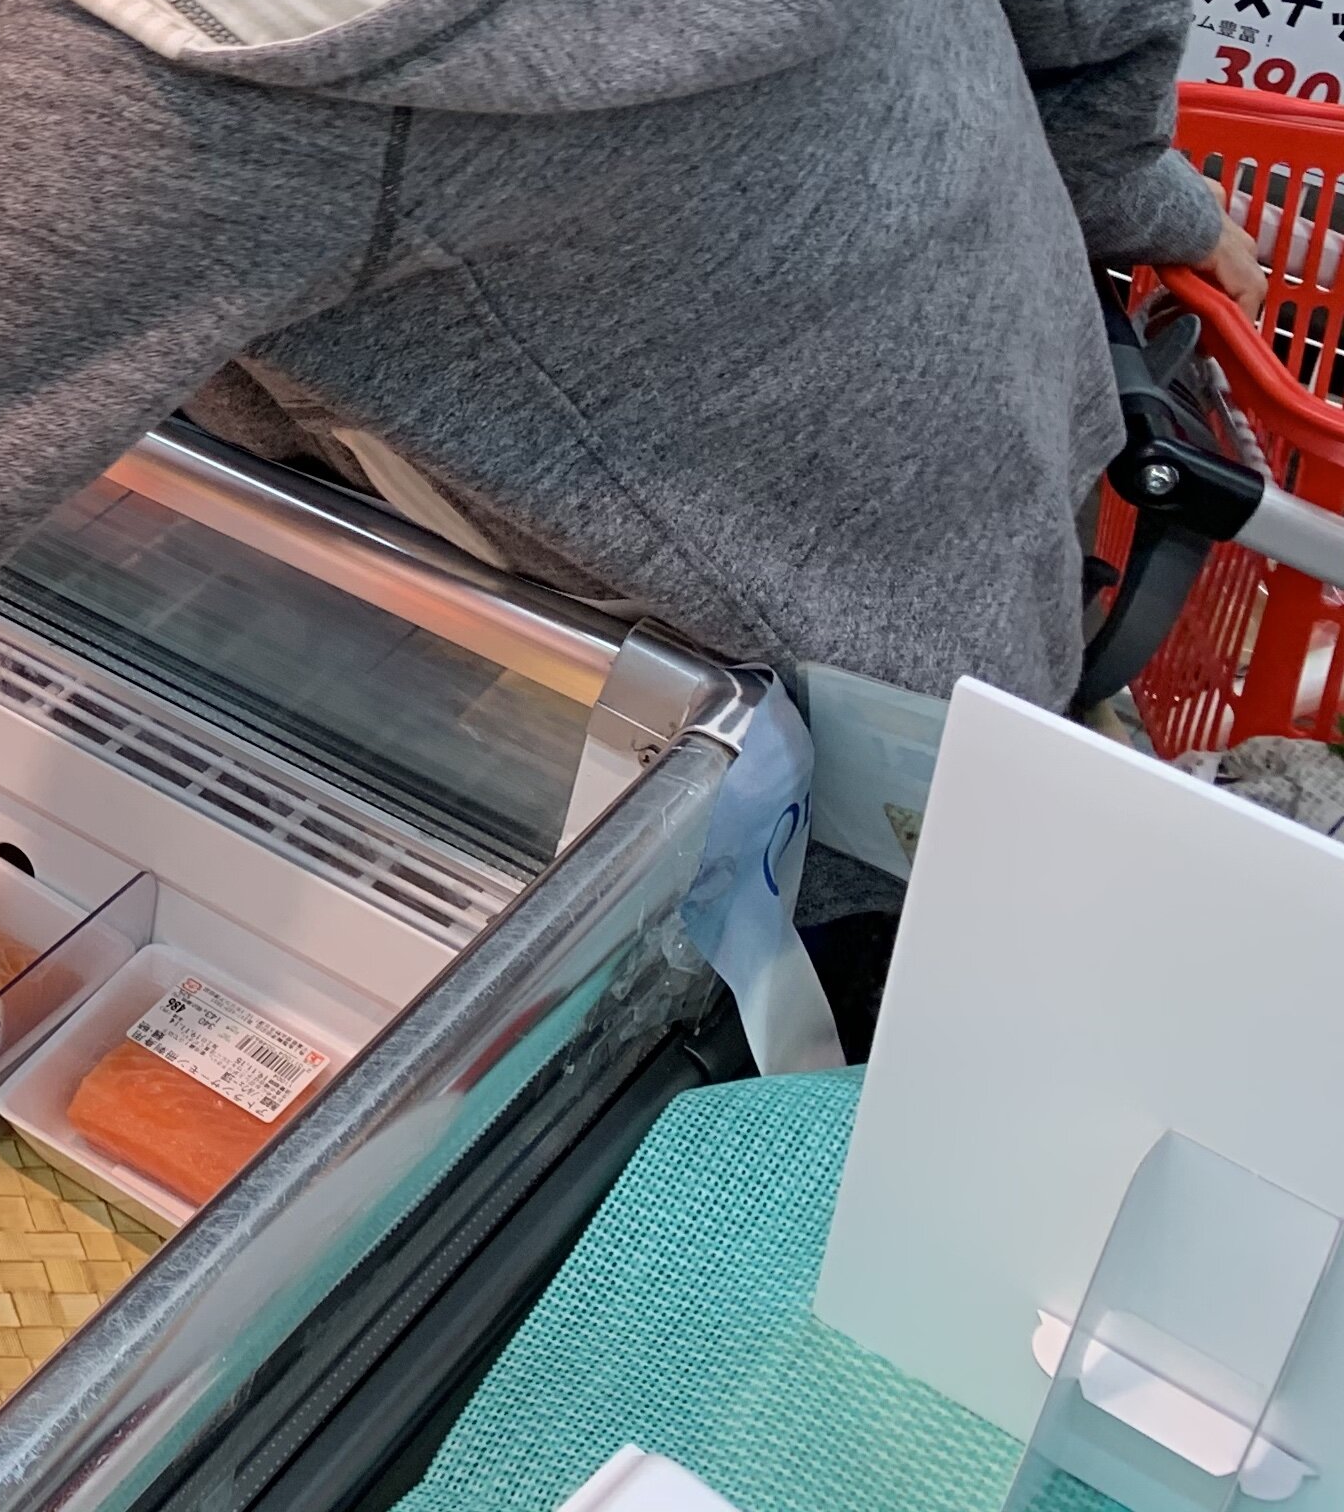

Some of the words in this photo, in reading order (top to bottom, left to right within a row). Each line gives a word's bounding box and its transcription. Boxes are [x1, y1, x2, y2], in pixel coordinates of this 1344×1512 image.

[1205, 44, 1342, 105] 390
[168, 1017, 202, 1039] 19.11.14
[233, 1057, 270, 1080] 19.11.15
